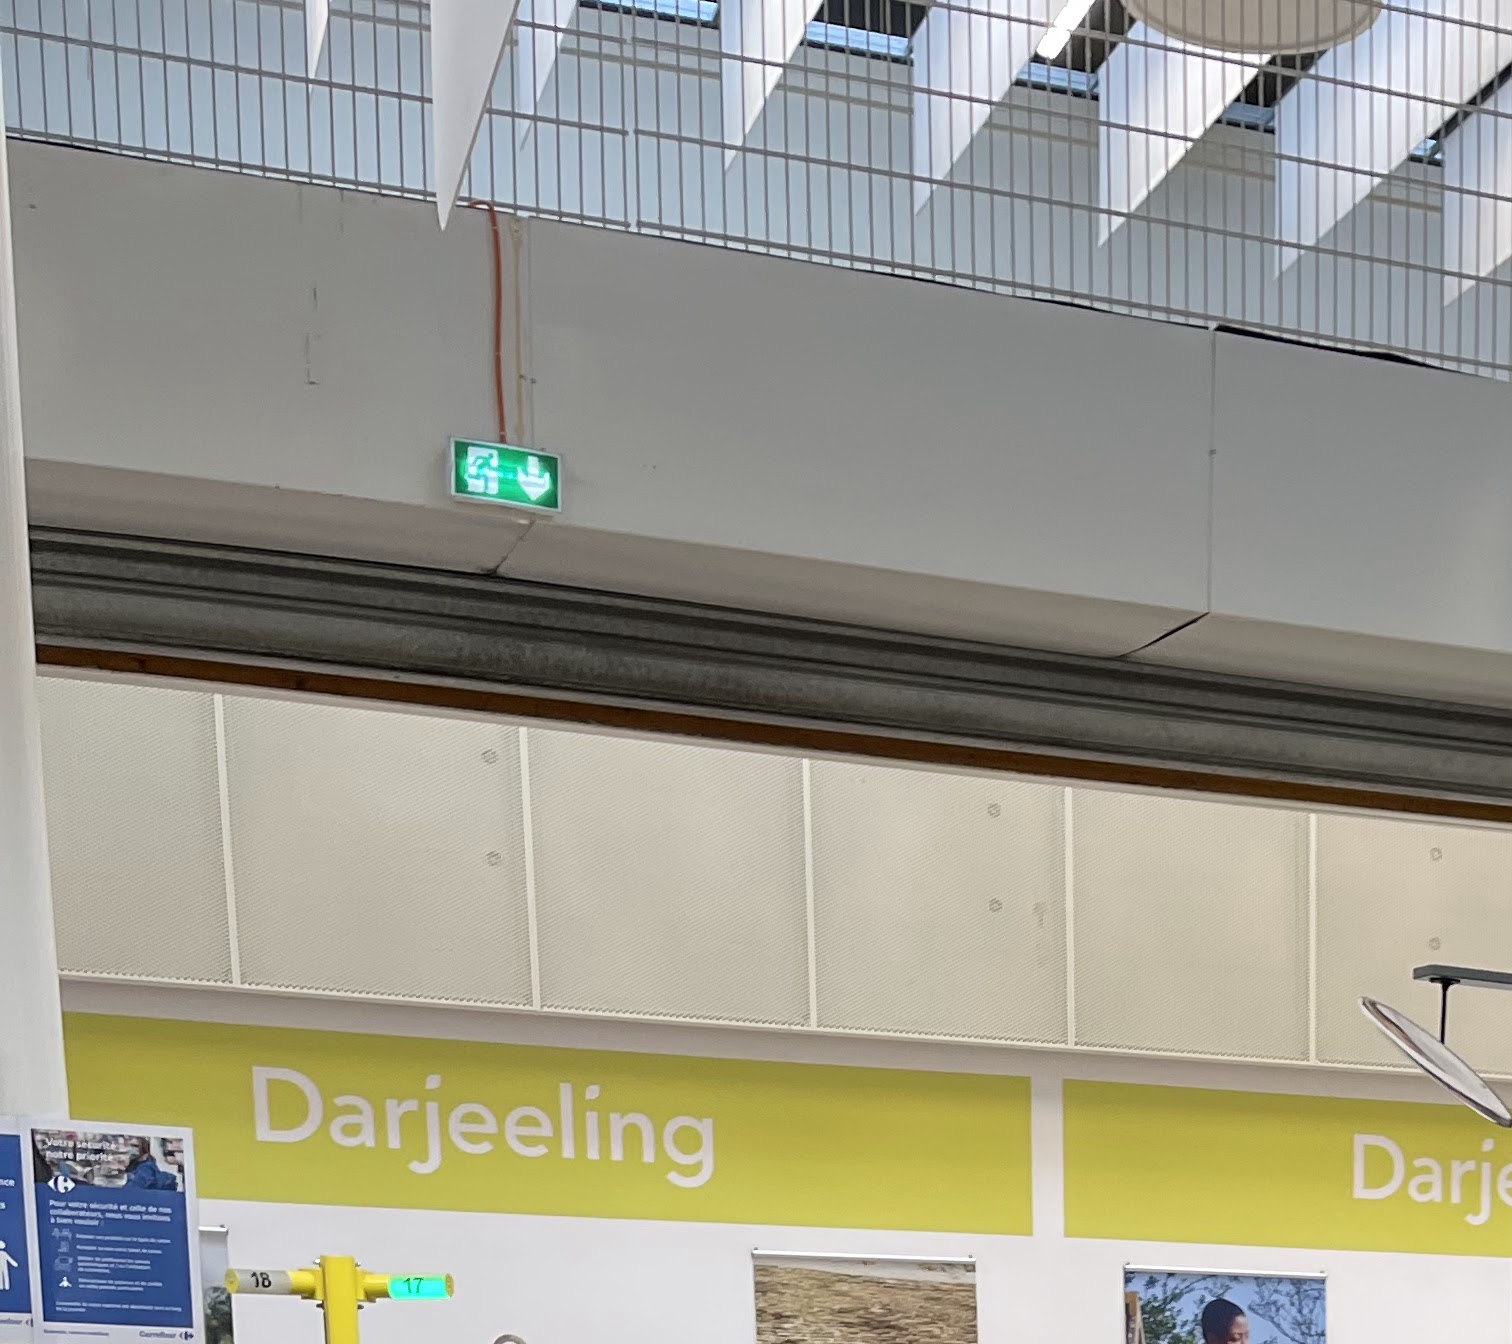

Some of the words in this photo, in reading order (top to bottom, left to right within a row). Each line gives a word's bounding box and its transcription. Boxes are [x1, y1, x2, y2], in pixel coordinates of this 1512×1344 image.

[252, 1065, 715, 1187] Darjeeling
[251, 1271, 272, 1289] 18
[402, 1276, 424, 1294] 17
